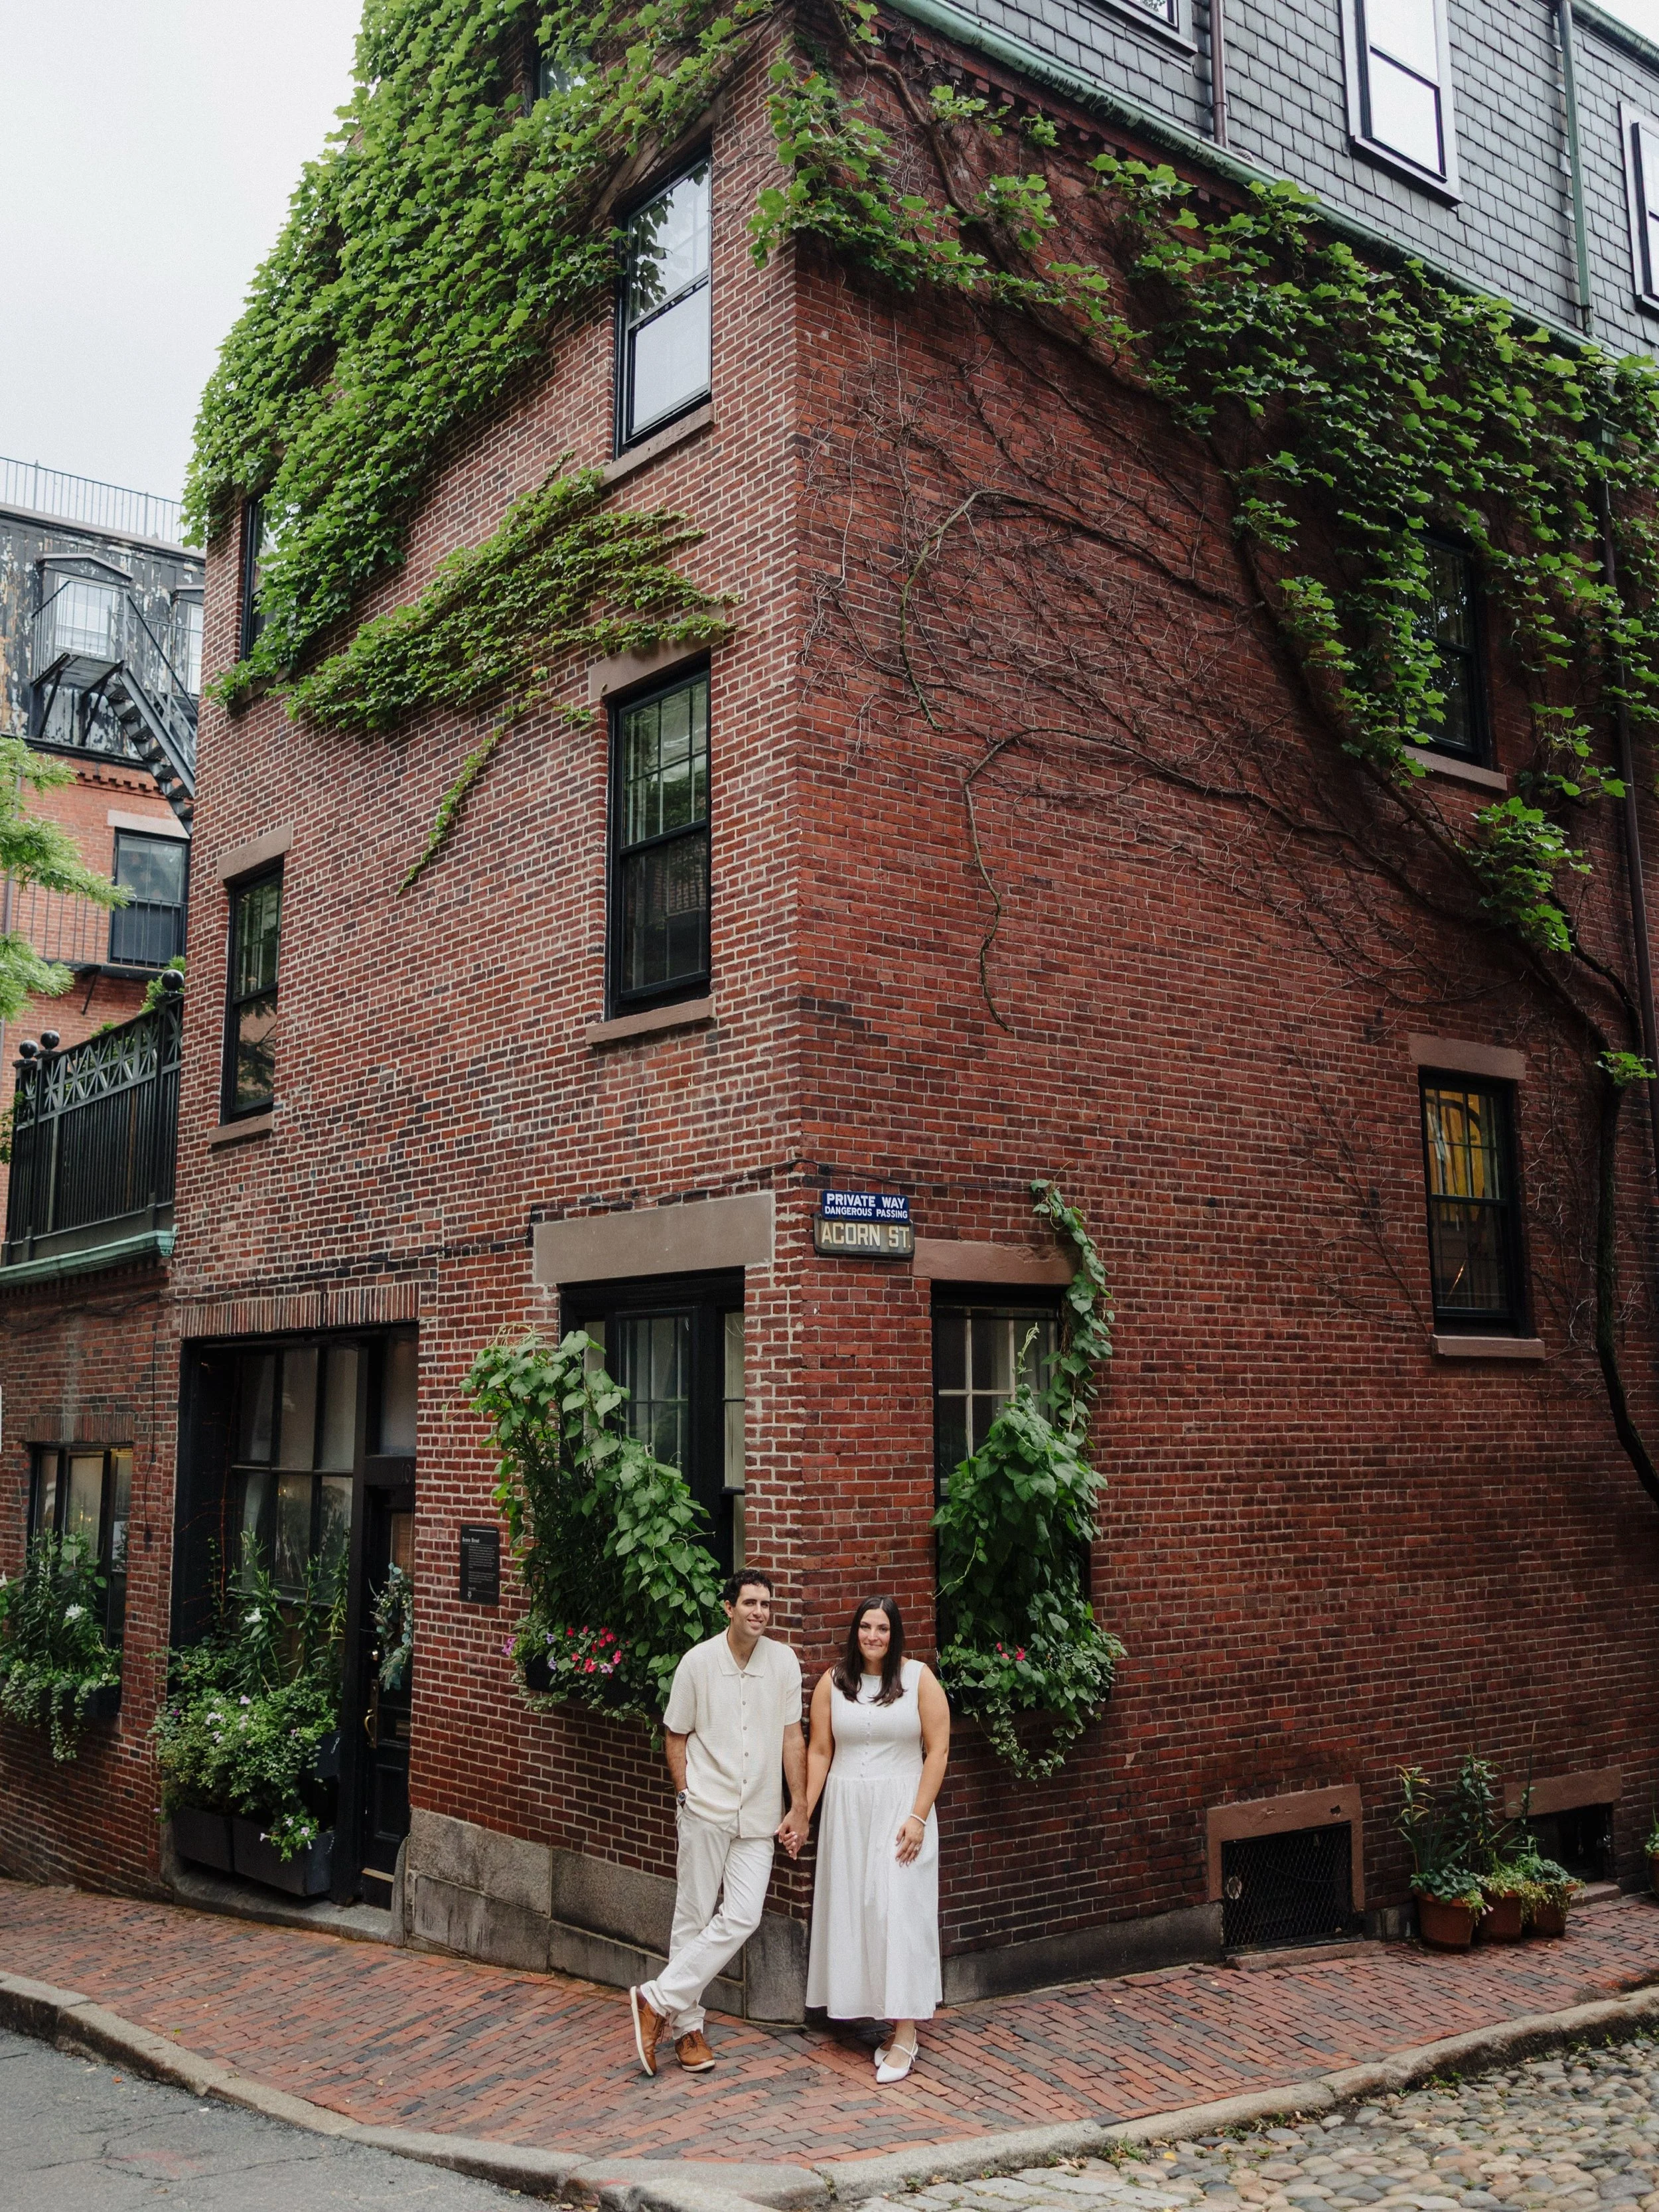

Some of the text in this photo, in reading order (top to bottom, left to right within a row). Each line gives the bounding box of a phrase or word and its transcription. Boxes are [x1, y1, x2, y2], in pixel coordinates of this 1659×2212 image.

[826, 1193, 905, 1209] PRIVATE WAY
[824, 1206, 908, 1218] DANGEROUS PASSING
[821, 1222, 912, 1248] ACORN ST.
